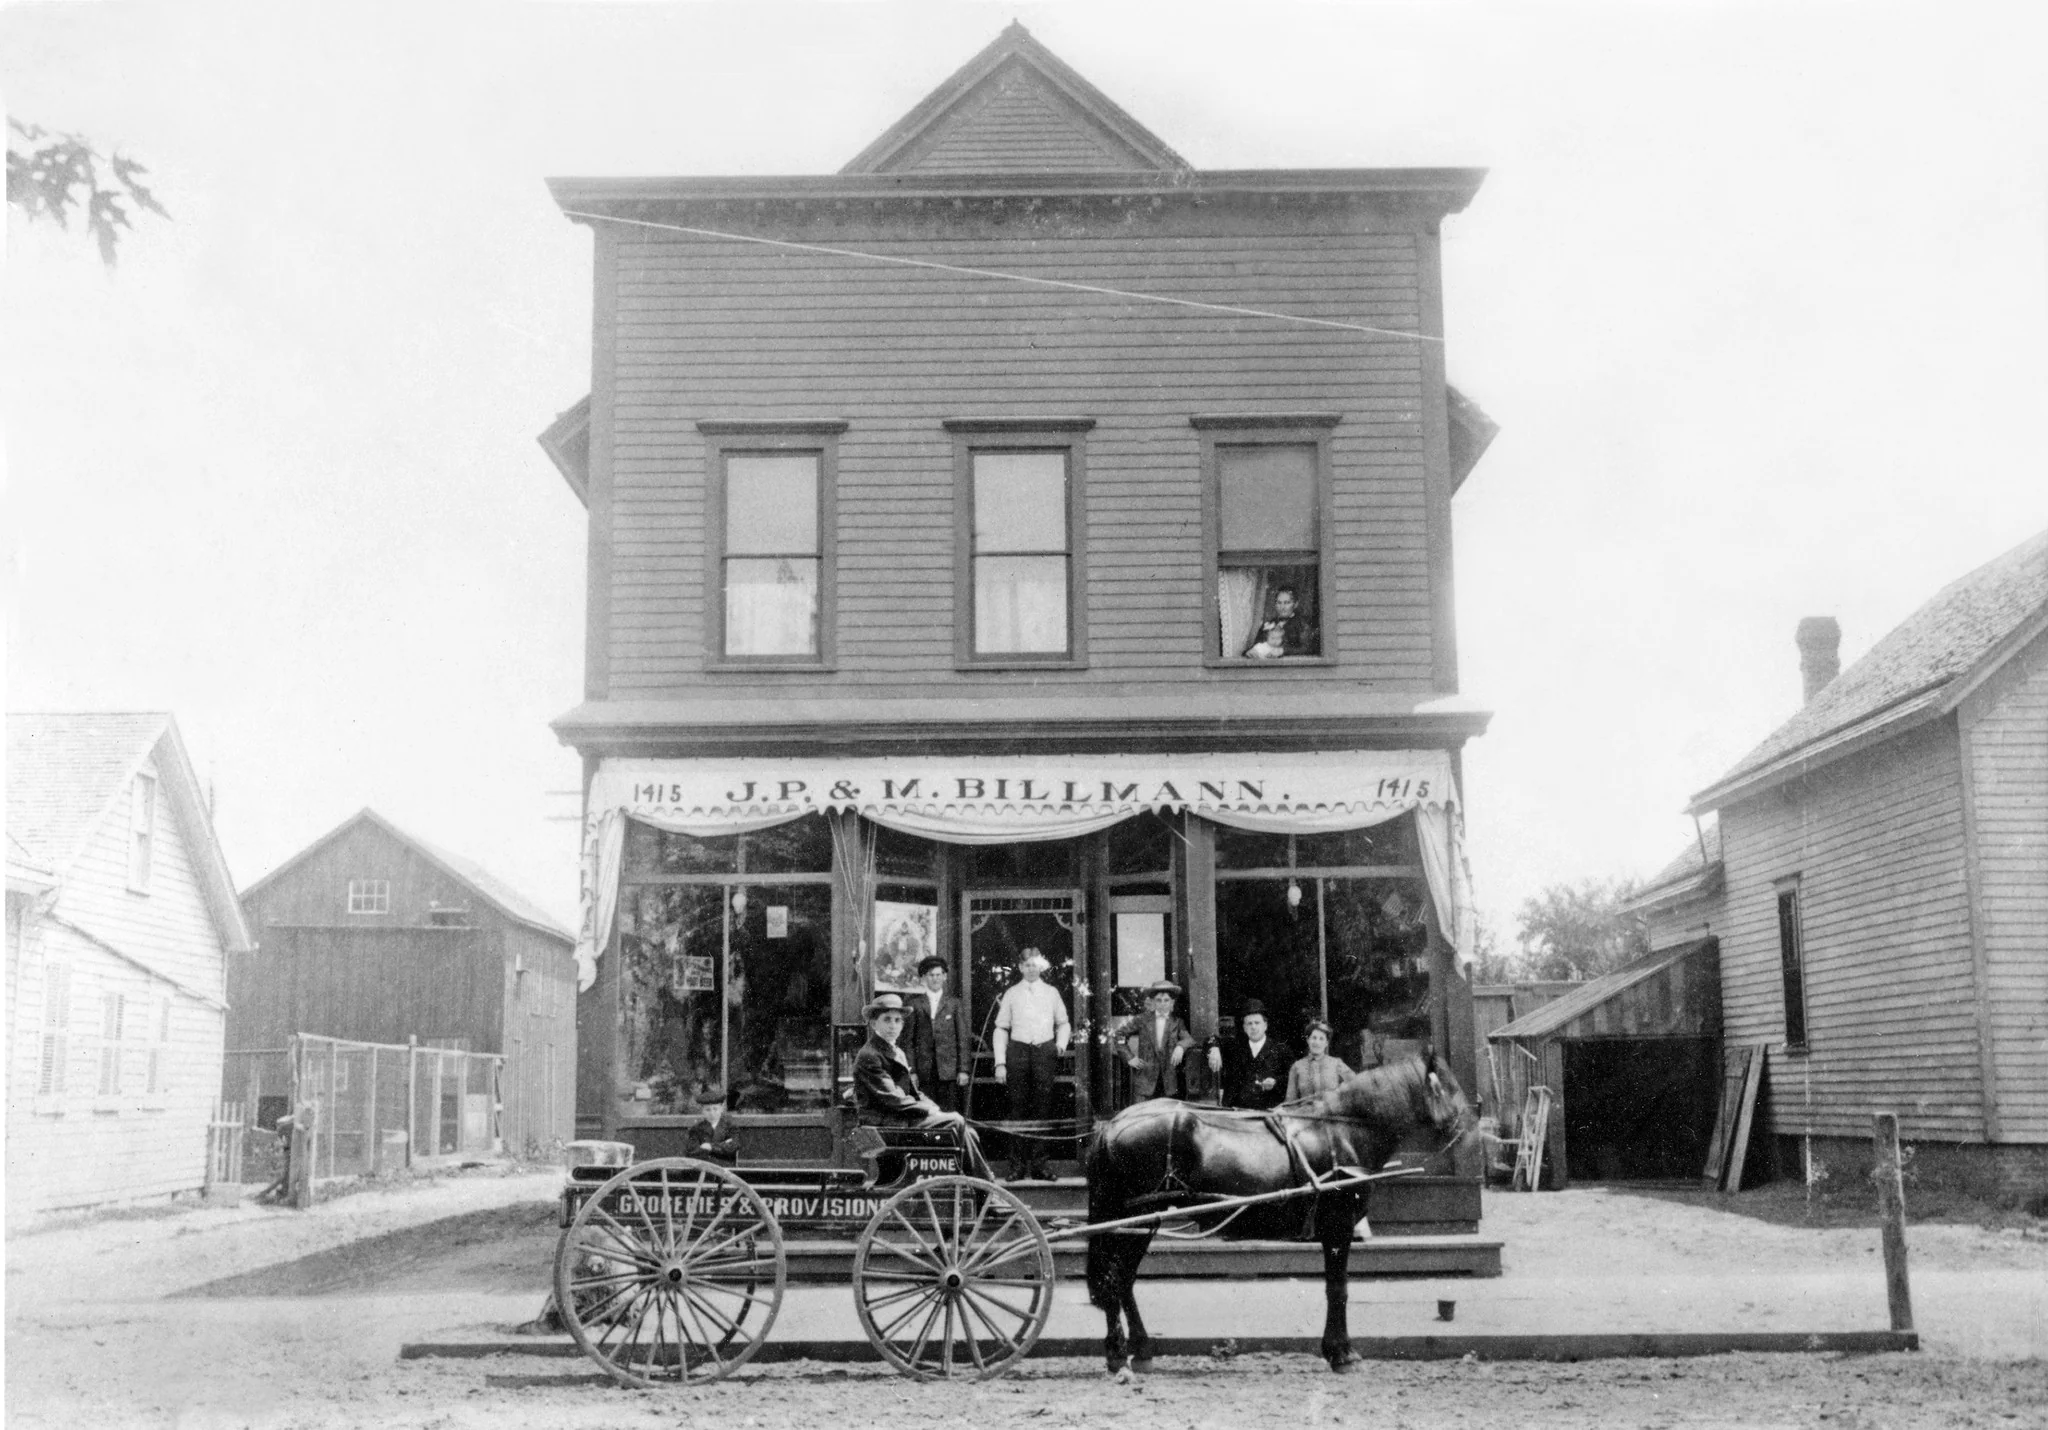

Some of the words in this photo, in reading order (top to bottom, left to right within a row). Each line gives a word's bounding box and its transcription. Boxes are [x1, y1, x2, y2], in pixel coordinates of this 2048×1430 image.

[634, 783, 682, 803] 1415
[829, 780, 861, 800] &
[1377, 778, 1430, 799] 1415
[909, 1158, 956, 1172] PHONE
[738, 1196, 756, 1216] &
